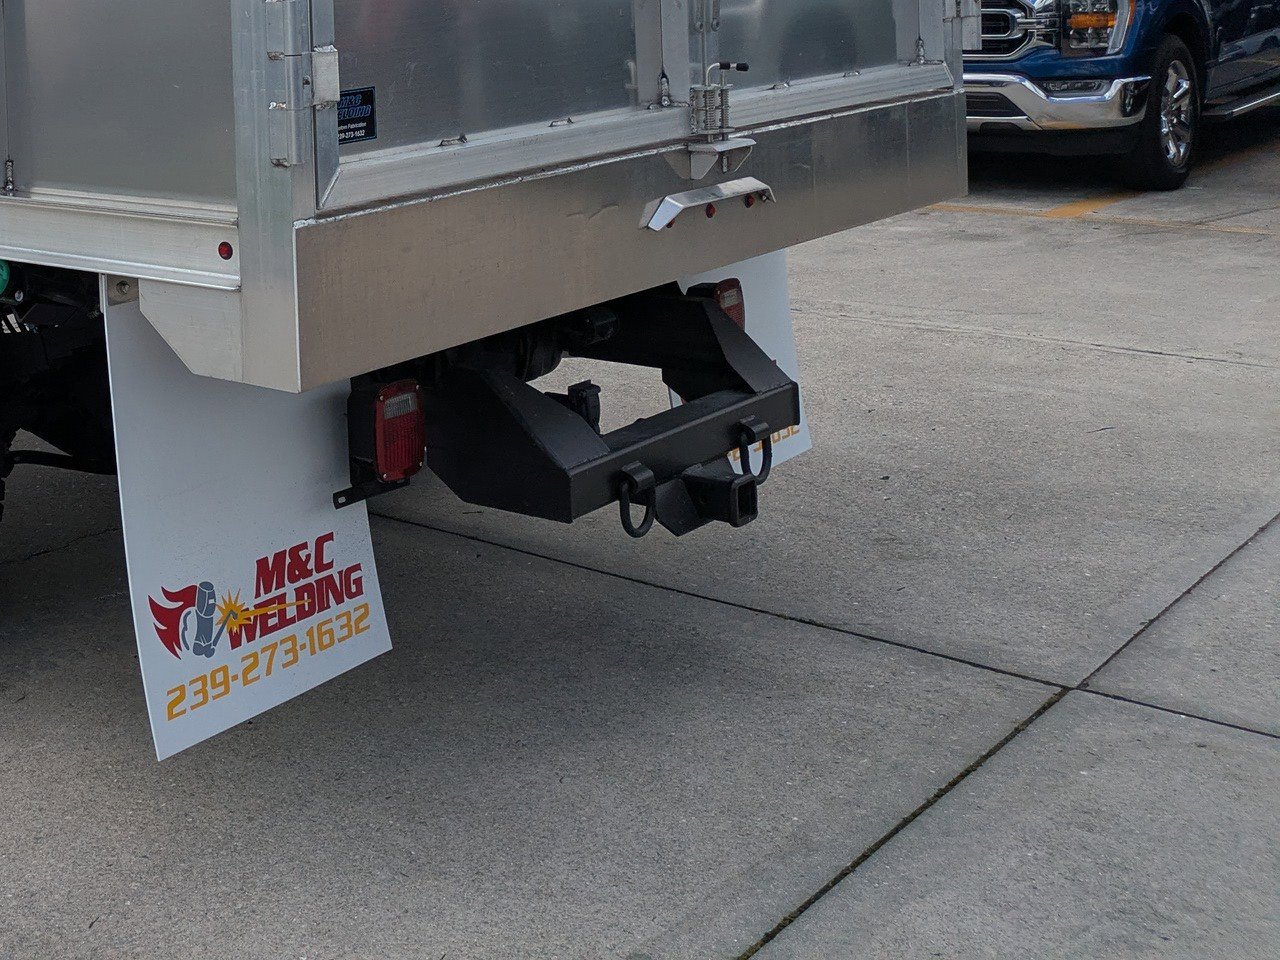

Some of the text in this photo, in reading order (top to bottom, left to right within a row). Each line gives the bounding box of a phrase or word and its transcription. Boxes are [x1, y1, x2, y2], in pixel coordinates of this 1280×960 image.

[228, 562, 364, 651] WELDING
[254, 531, 335, 599] M&C
[166, 602, 371, 722] 239-273-1632
